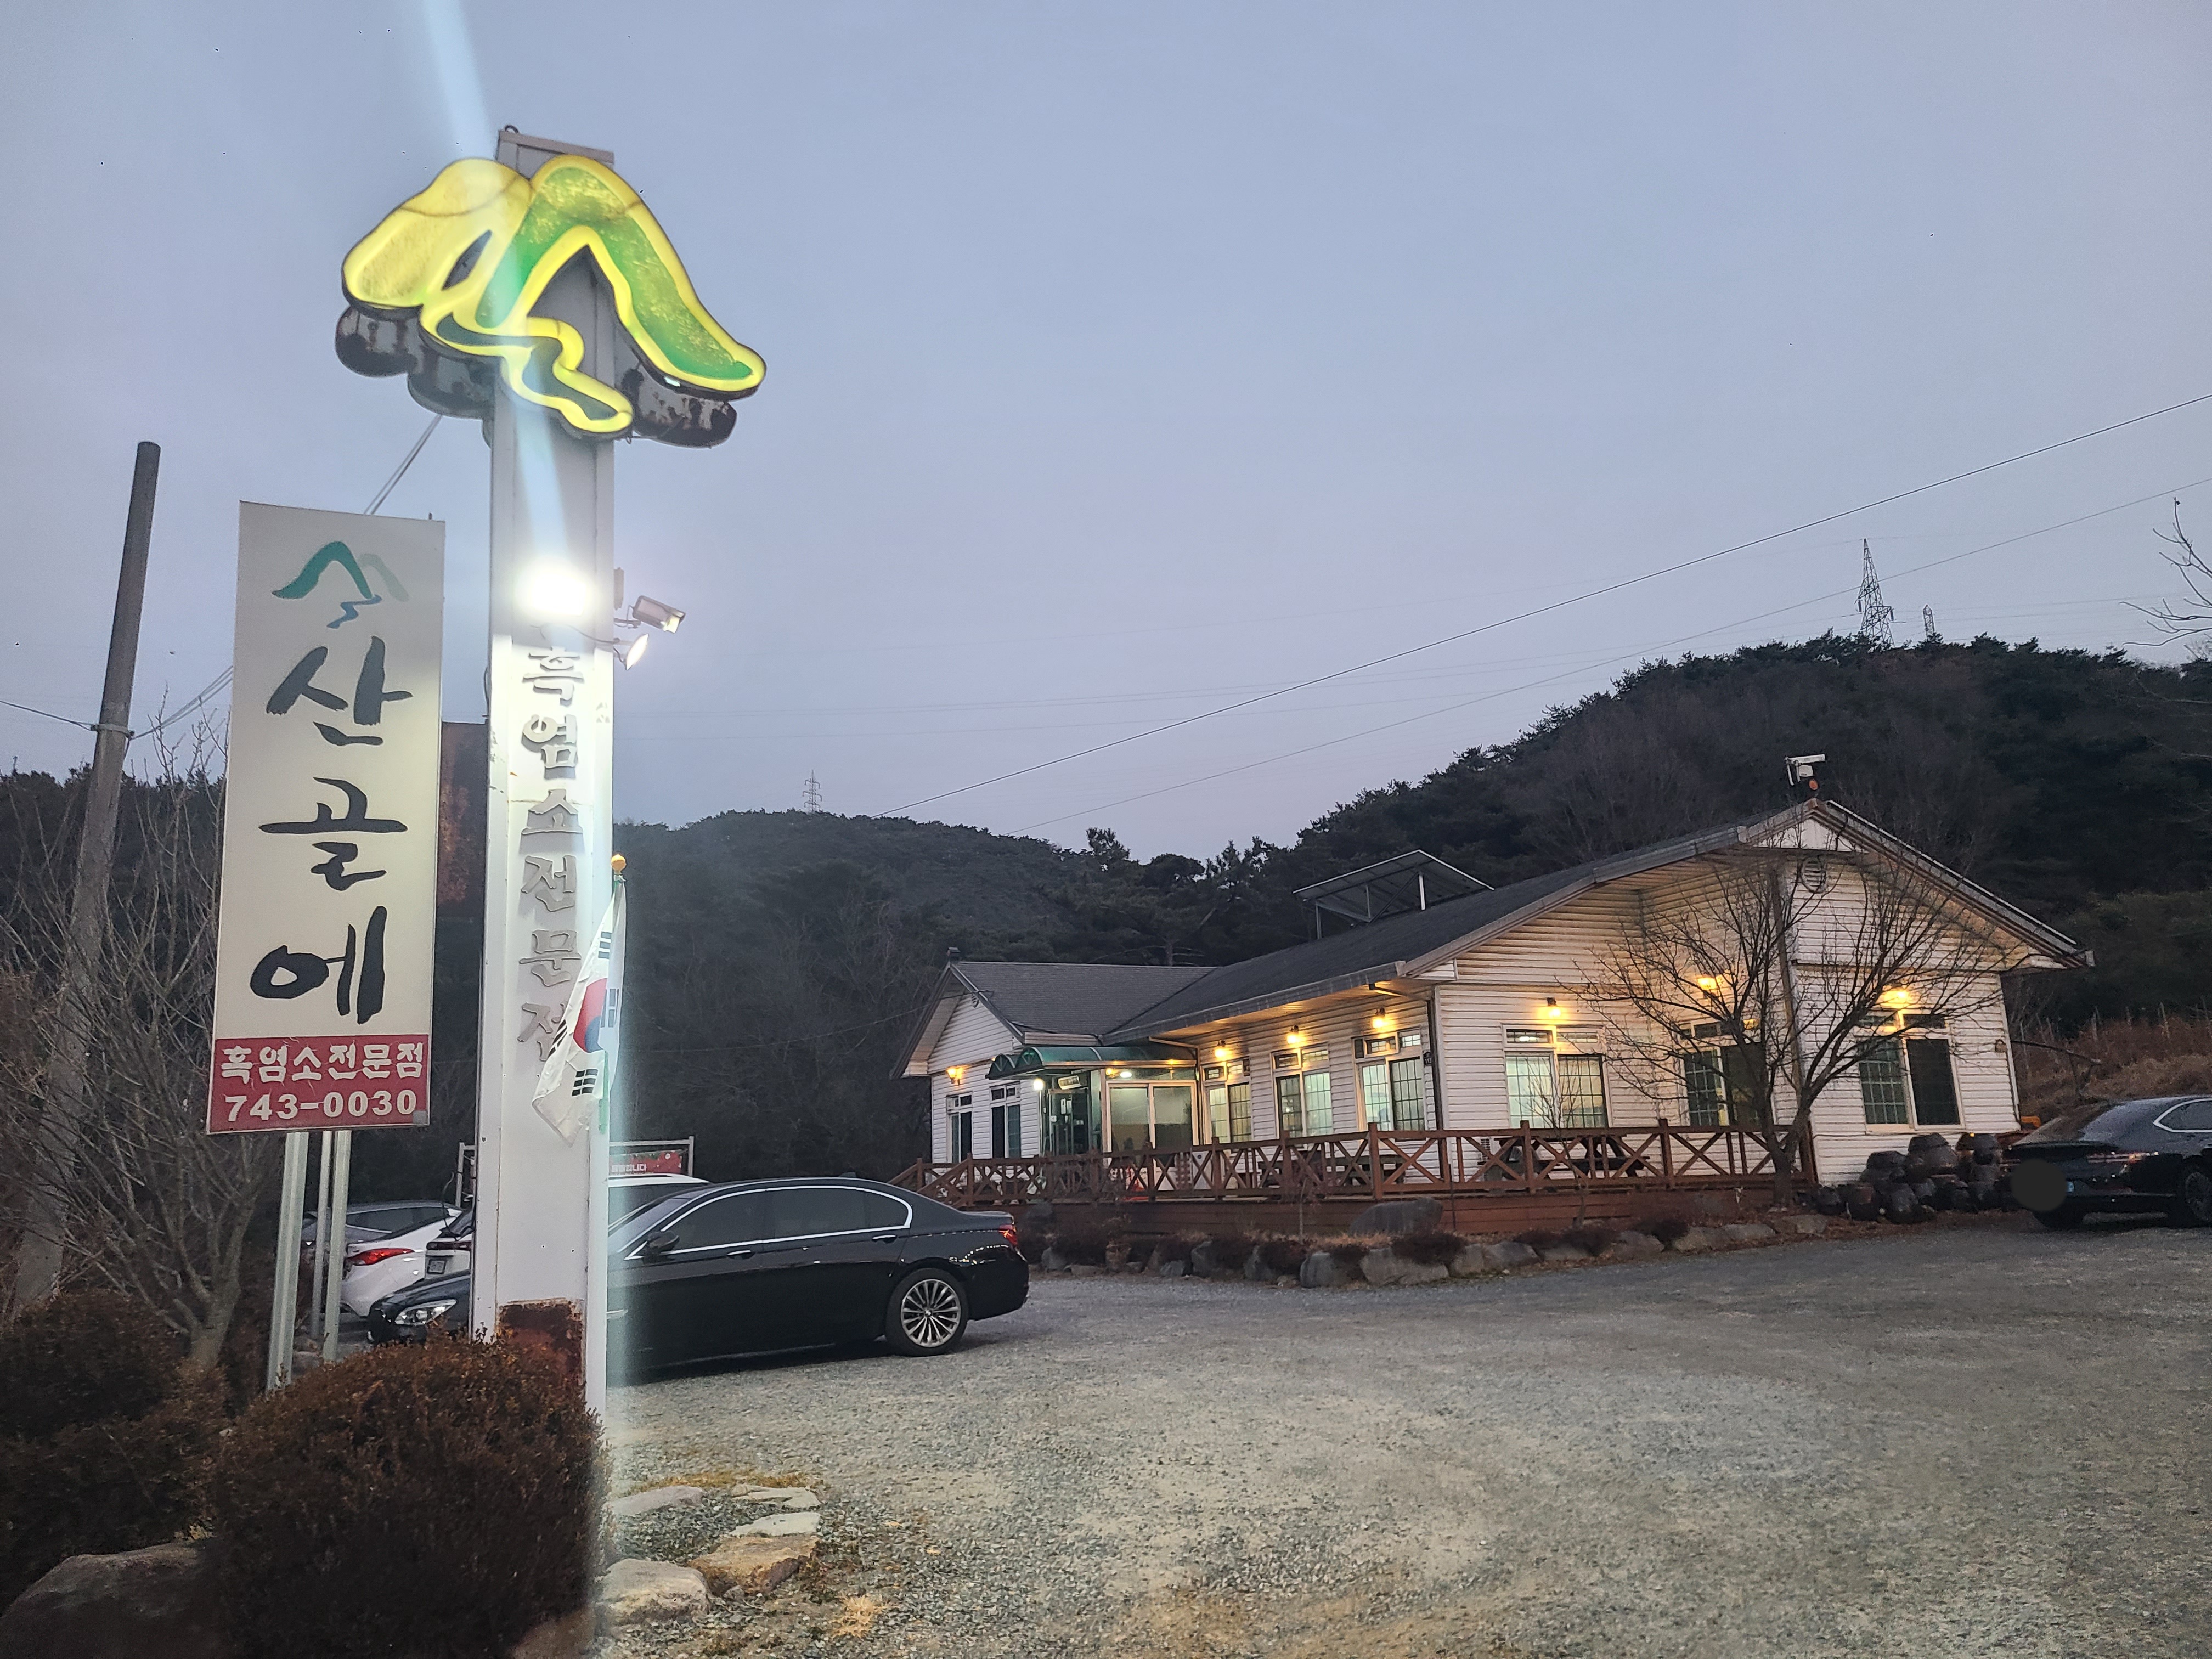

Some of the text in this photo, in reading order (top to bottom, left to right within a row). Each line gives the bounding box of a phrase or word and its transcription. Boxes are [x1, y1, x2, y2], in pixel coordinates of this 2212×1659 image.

[250, 635, 413, 1025] 산골에
[221, 1042, 423, 1084] 흑염소전문점
[224, 1090, 417, 1122] 743-0030
